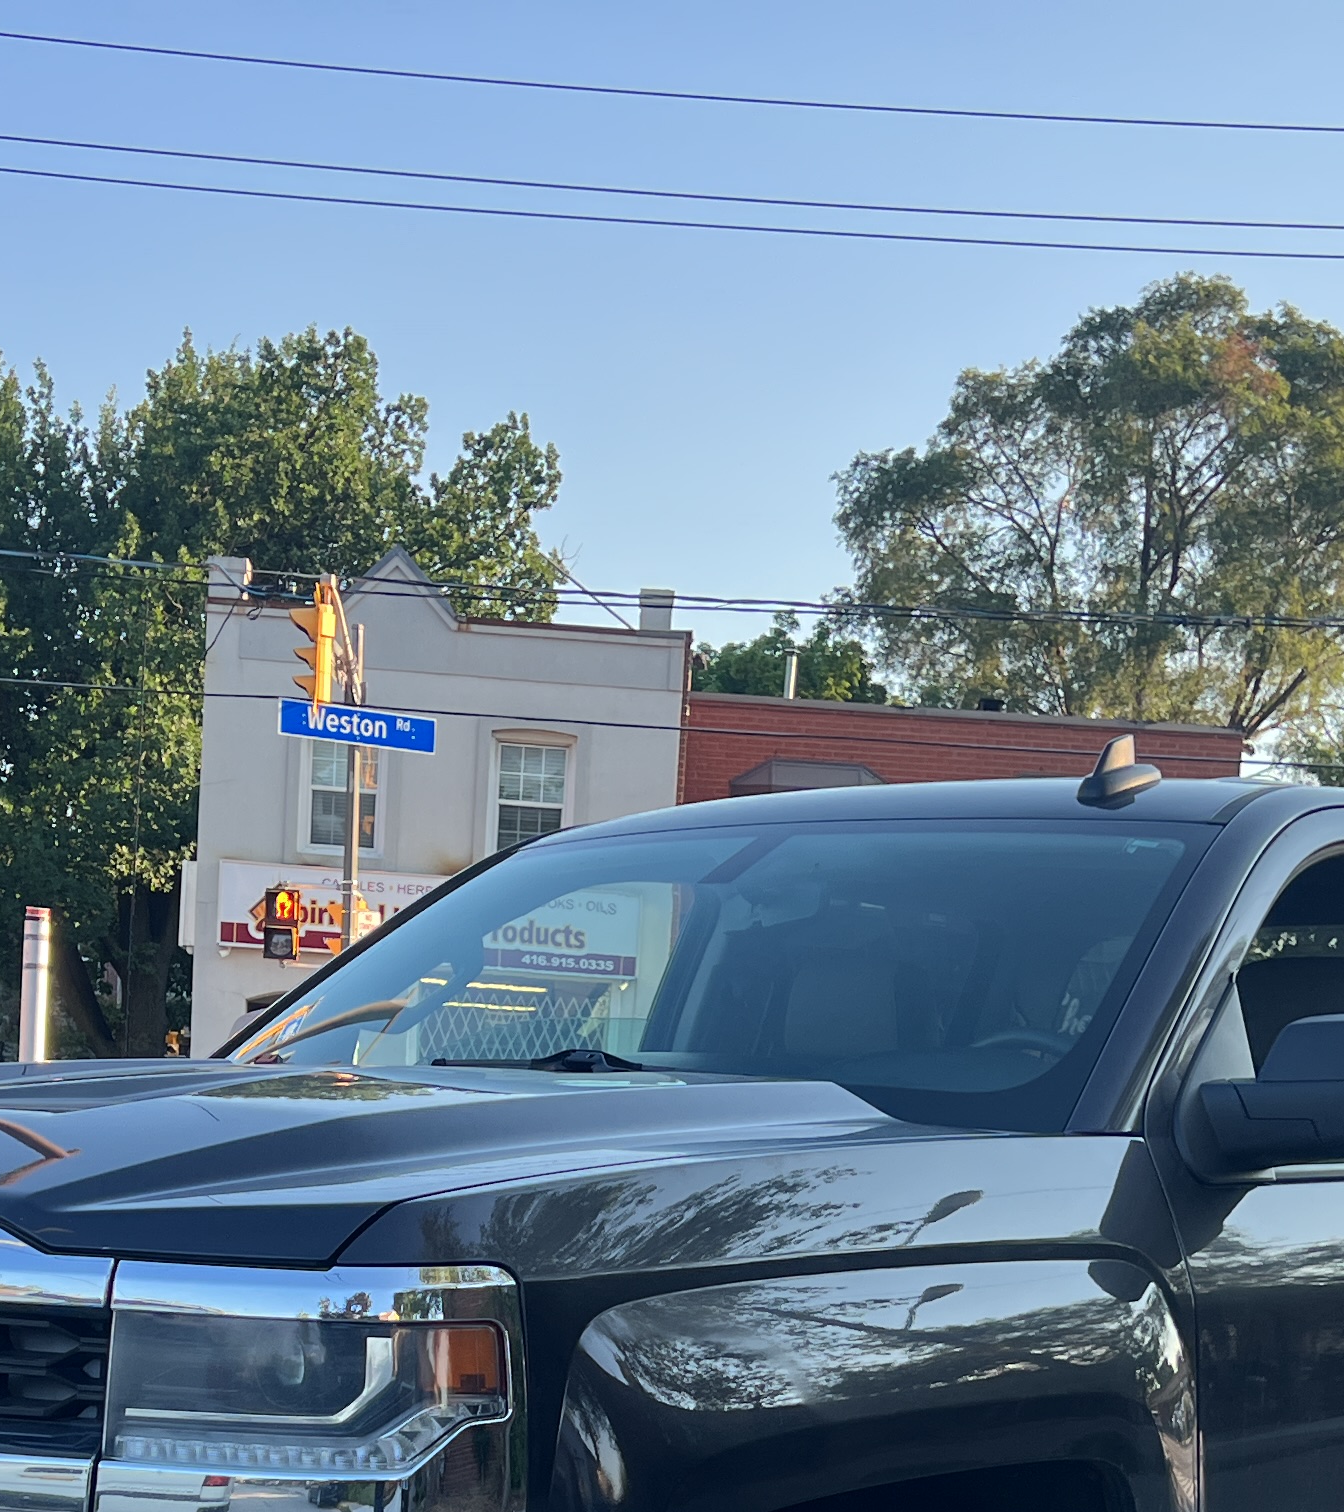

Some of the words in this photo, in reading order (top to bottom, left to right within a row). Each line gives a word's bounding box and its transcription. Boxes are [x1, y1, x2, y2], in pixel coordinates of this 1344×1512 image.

[307, 705, 387, 739] Weston
[395, 718, 411, 732] Rd
[322, 878, 385, 892] CALES
[585, 900, 617, 915] OILS
[490, 919, 586, 949] roducts
[521, 953, 614, 971] 416.915.0335
